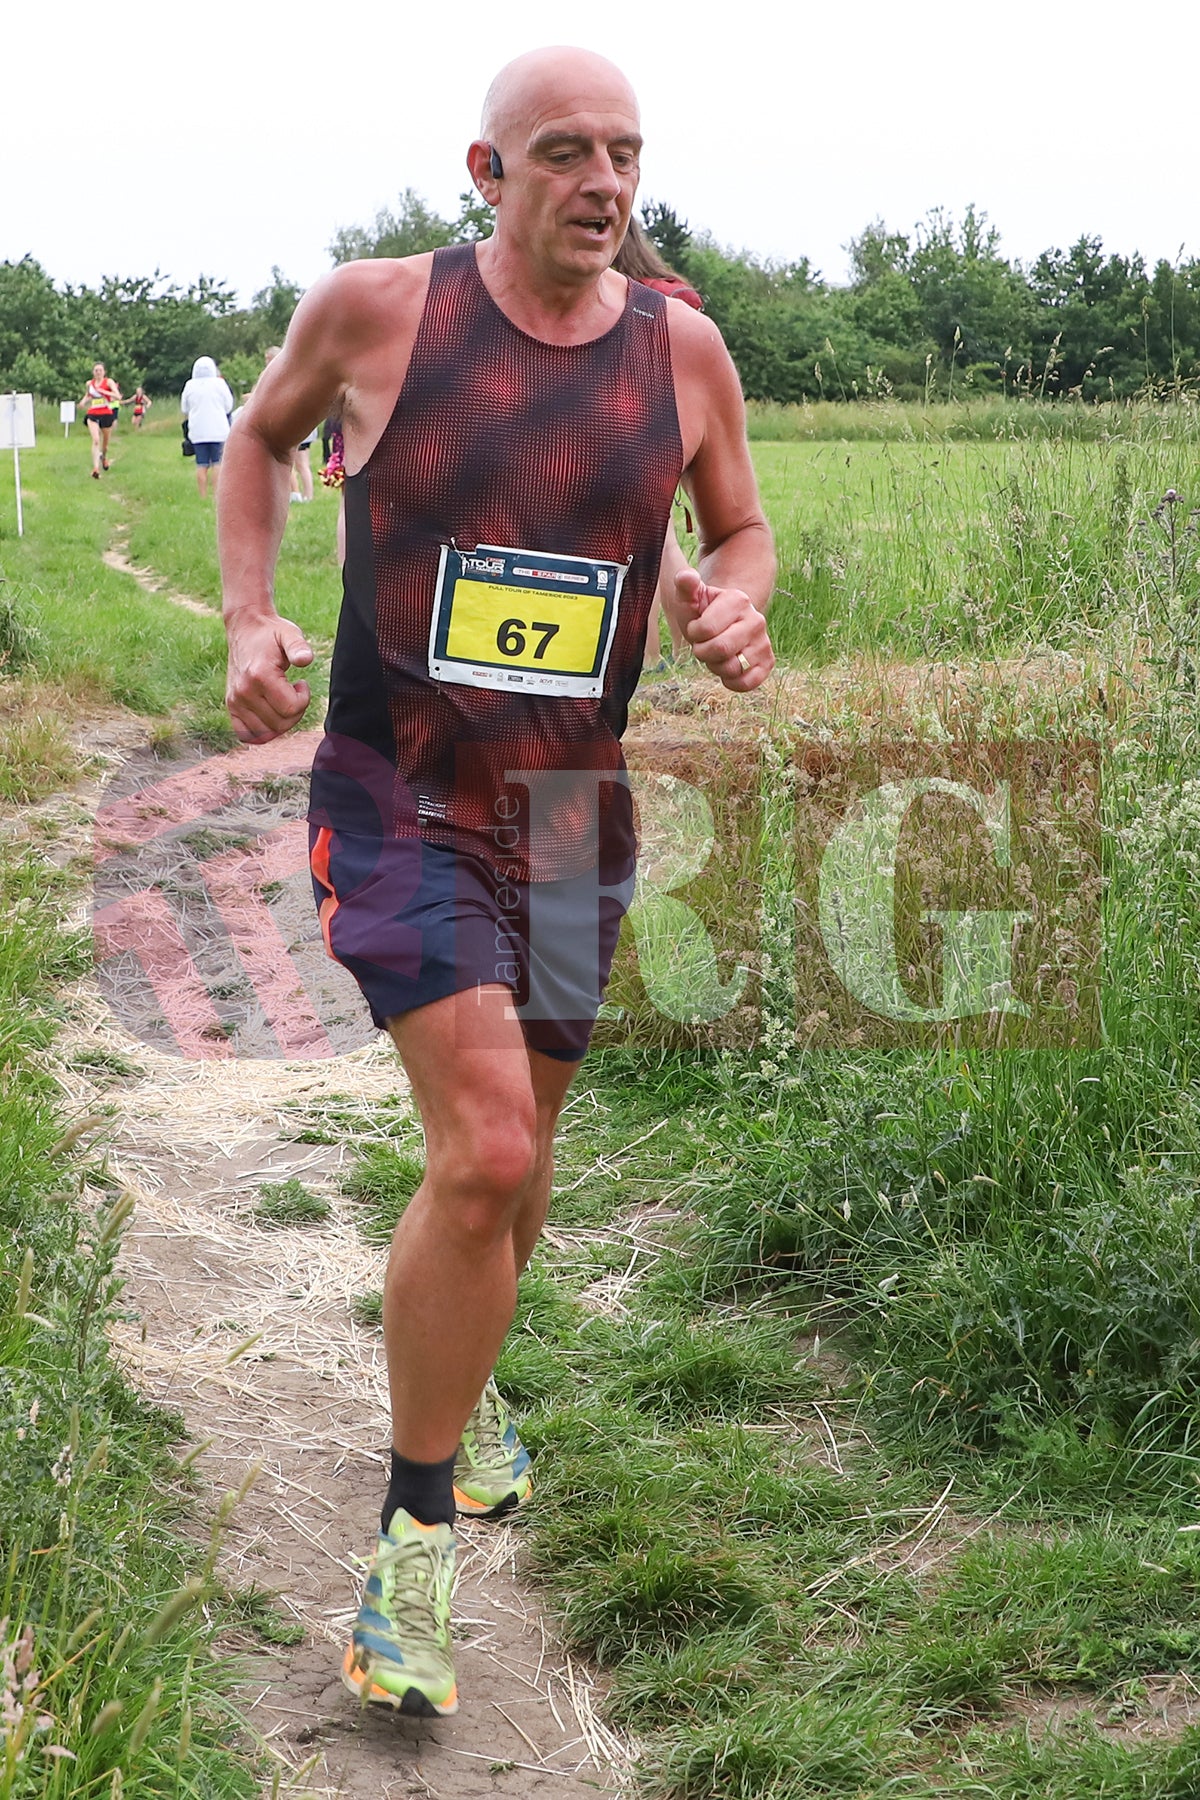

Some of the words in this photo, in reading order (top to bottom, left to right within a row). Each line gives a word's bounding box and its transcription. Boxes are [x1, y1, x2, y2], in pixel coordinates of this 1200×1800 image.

[469, 558, 504, 572] TOUR
[532, 590, 563, 599] TAMESIDE
[496, 618, 560, 660] 67
